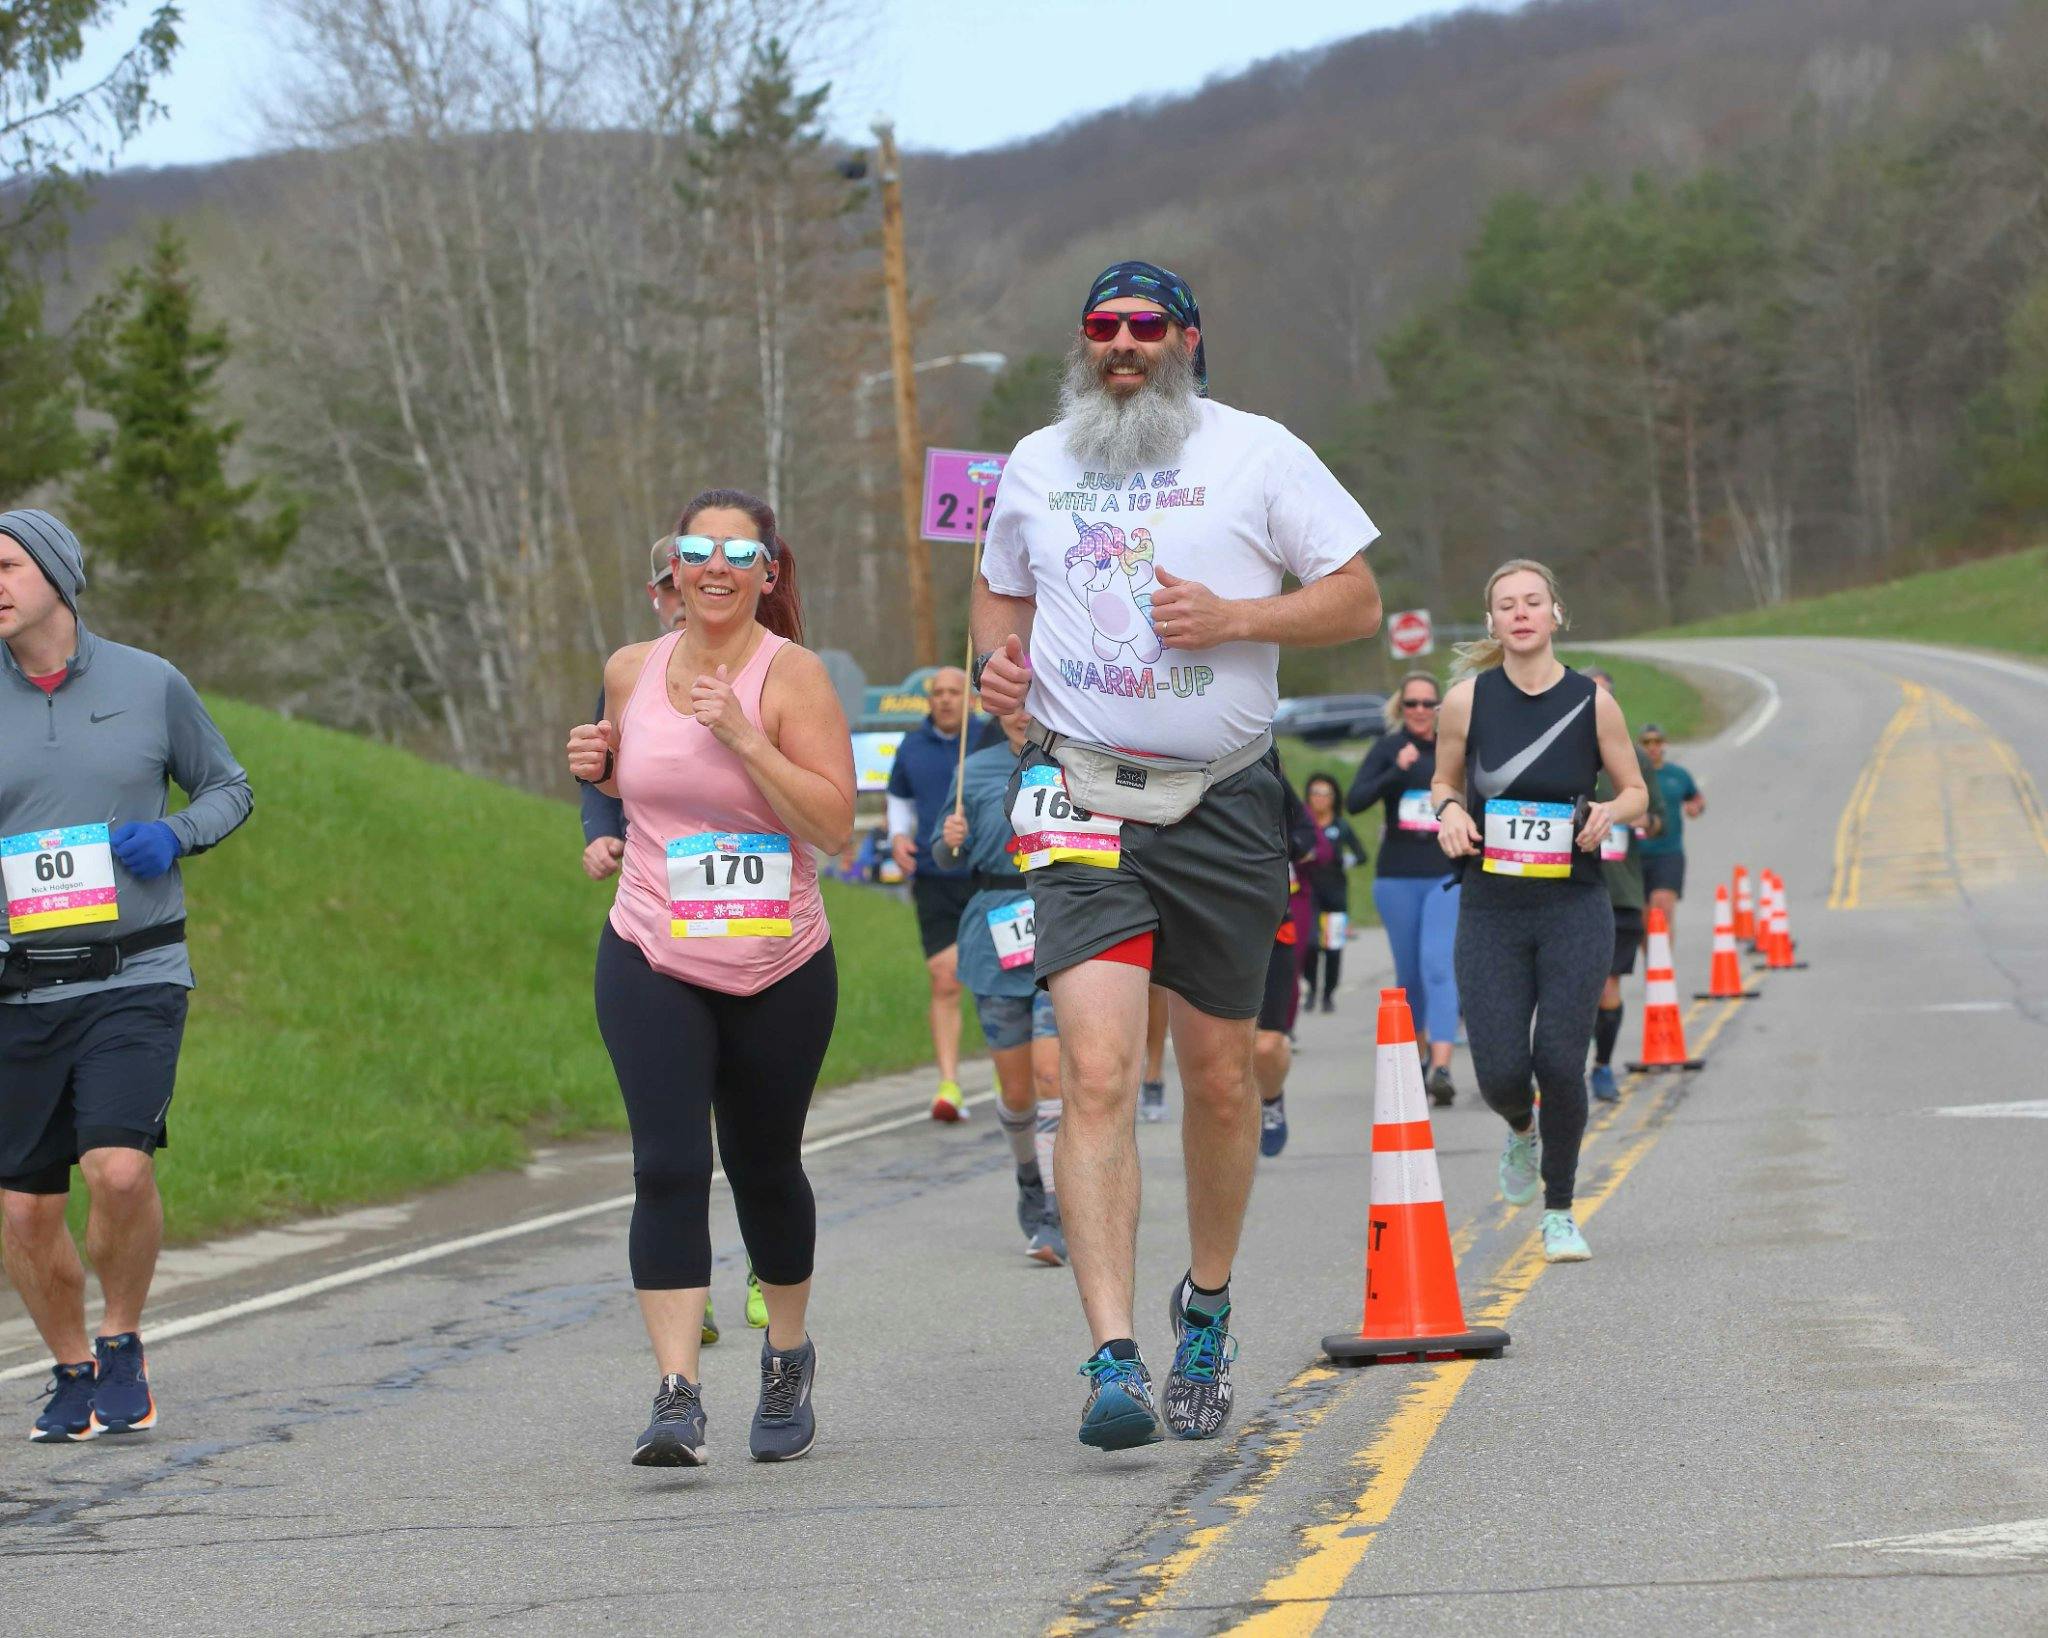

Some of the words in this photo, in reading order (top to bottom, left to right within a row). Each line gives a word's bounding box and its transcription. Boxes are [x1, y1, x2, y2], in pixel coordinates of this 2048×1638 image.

[1077, 471, 1126, 490] JUST
[1128, 472, 1146, 490] A
[1048, 491, 1098, 512] WITH
[1101, 494, 1119, 512] A
[1128, 493, 1151, 511] 10
[1155, 486, 1206, 509] MILE
[1060, 658, 1214, 699] WARM-UP
[1117, 779, 1144, 789] NATHAN
[1507, 818, 1551, 841] 173
[35, 850, 74, 882] 60
[699, 854, 764, 886] 170
[1368, 1220, 1387, 1251] T
